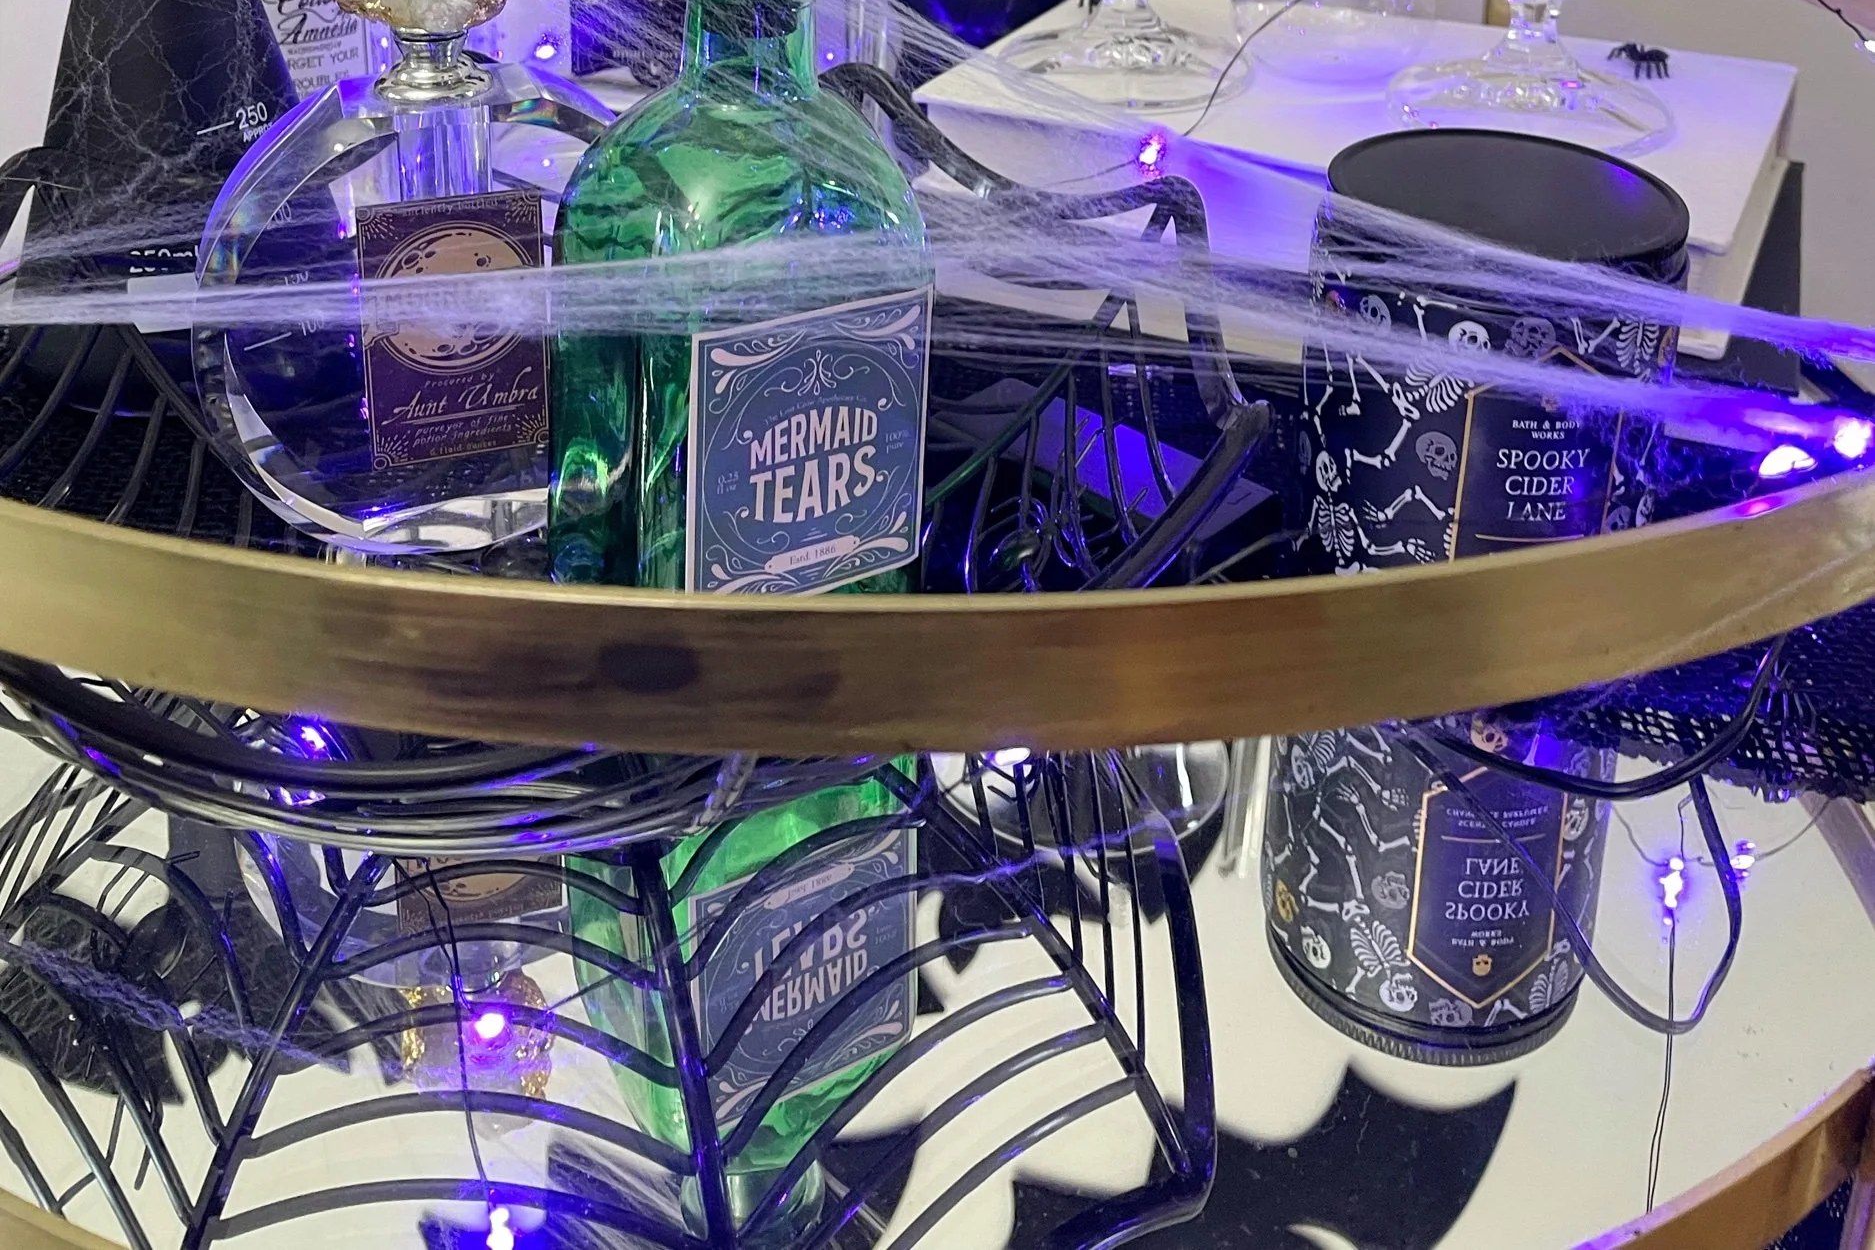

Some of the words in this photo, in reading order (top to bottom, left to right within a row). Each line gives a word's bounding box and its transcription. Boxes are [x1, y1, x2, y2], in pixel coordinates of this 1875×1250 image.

[330, 46, 360, 65] YOUR
[236, 101, 268, 130] 250
[381, 390, 448, 426] Aunt
[458, 366, 539, 410] Umbra
[413, 434, 449, 448] potion
[453, 424, 512, 441] ingredients
[415, 421, 464, 437] purveyor
[470, 417, 481, 428] of
[487, 414, 509, 427] fine
[1512, 419, 1537, 430] BATH
[1542, 419, 1551, 430] &
[1555, 420, 1581, 430] BODY
[1531, 431, 1565, 440] WORKS
[750, 405, 878, 471] MERMAID
[1496, 448, 1591, 471] SPOOKY
[750, 444, 877, 524] TEARS
[1504, 475, 1575, 496] CIDER
[1506, 500, 1567, 522] LANE
[814, 545, 837, 559] 1886
